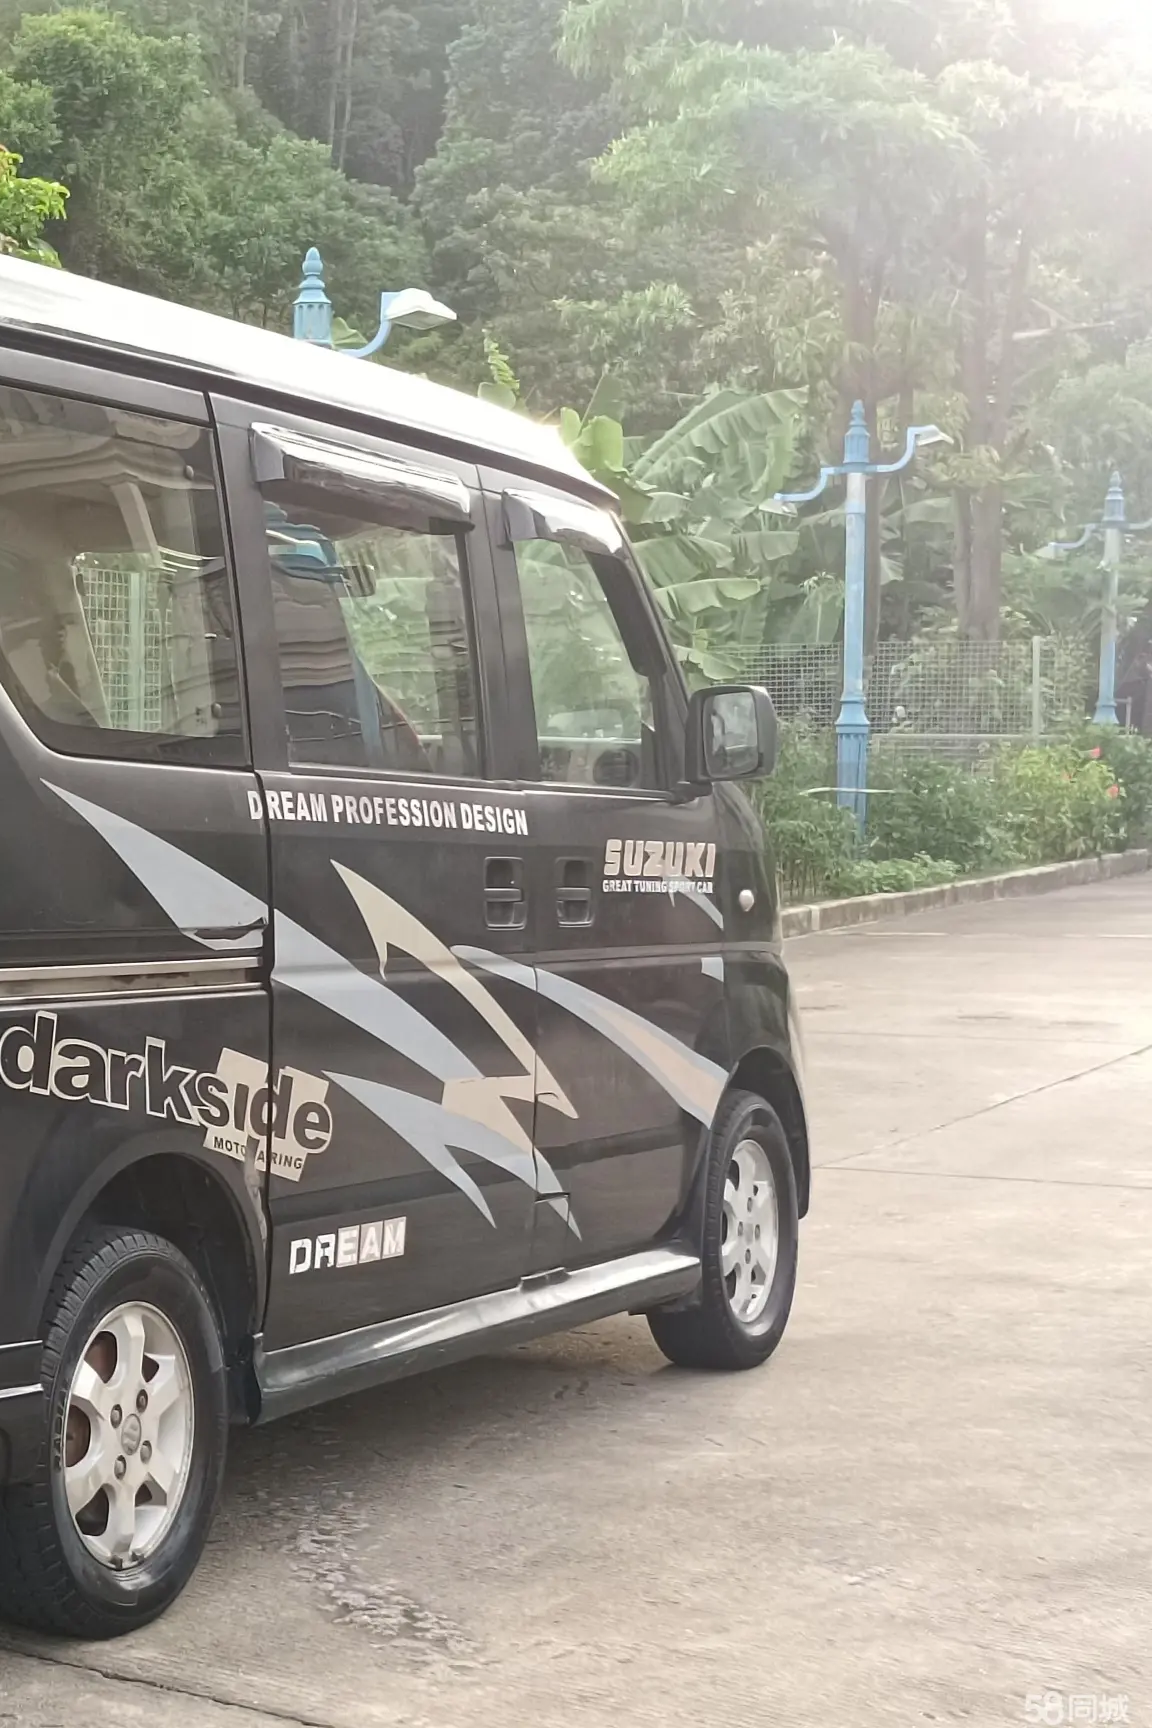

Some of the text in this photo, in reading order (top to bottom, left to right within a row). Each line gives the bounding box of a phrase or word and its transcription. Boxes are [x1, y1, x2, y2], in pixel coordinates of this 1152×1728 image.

[247, 790, 529, 836] DREAM PROFESSION DESIGN
[603, 838, 717, 878] SUZUKI
[602, 879, 633, 893] GREAT
[633, 880, 667, 894] TUNING
[696, 881, 714, 894] CAR
[289, 1216, 407, 1275] DREAM
